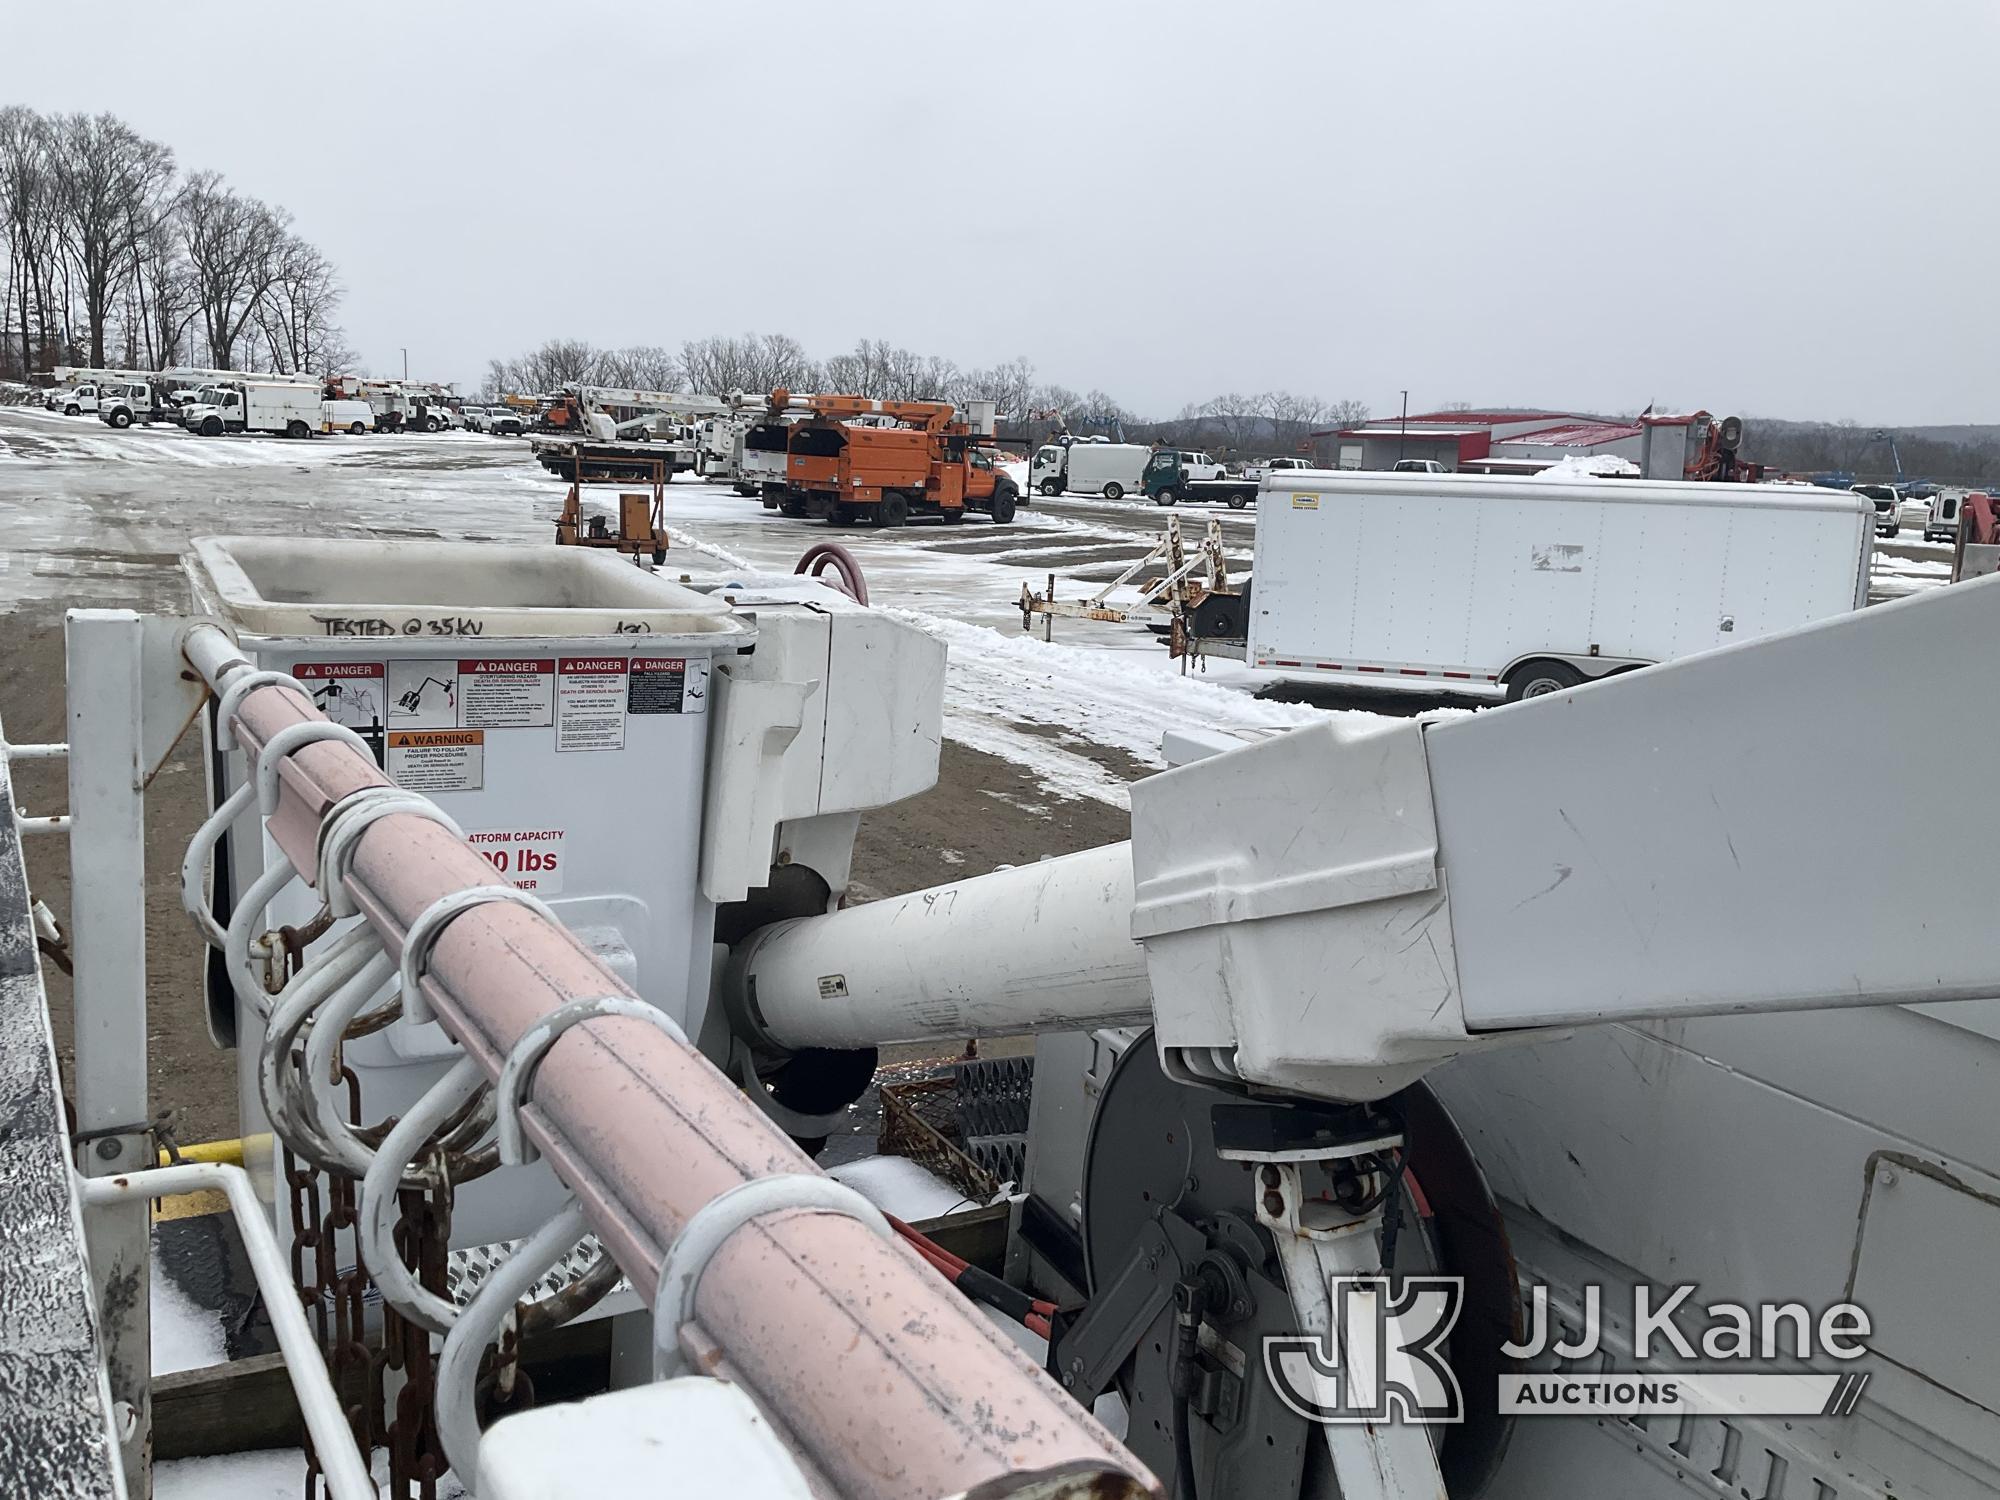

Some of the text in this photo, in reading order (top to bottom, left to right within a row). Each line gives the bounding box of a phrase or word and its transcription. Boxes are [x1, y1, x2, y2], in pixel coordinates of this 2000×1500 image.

[402, 618, 422, 635] @
[488, 662, 538, 672] DANGER
[576, 662, 621, 670] DANGER
[645, 661, 683, 669] DANGER
[324, 666, 372, 675] DANGER
[414, 734, 473, 744] WARNING
[468, 831, 564, 843] ATFORM CAPACITY
[518, 849, 557, 872] lbs
[513, 880, 537, 889] NER
